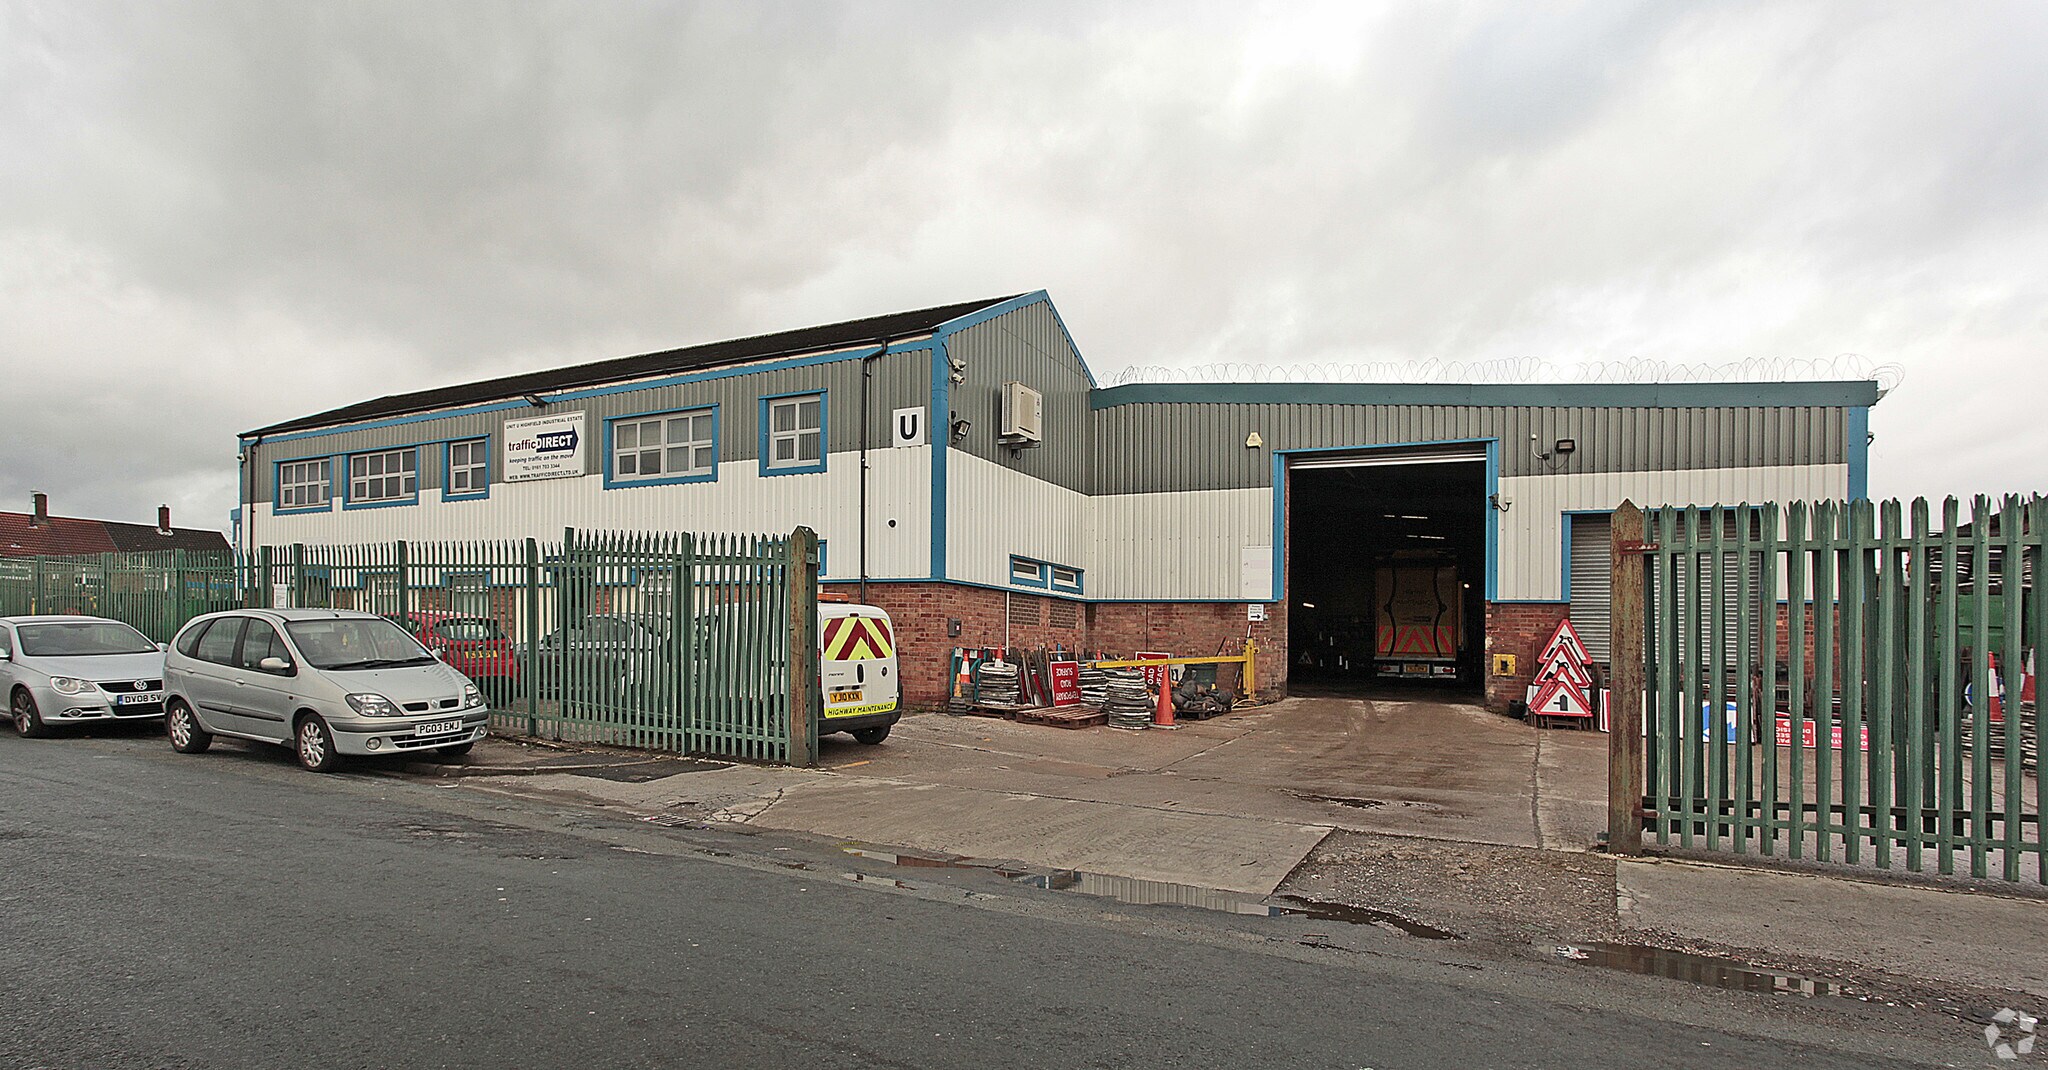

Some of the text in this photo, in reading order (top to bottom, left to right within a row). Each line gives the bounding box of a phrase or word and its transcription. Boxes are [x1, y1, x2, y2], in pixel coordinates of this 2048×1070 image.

[800, 414, 817, 440] U
[509, 456, 527, 464] keeping
[1147, 668, 1155, 685] OAD
[125, 694, 161, 703] DV08 SV
[828, 703, 893, 716] HIGHWAY MAINTENANCE
[419, 723, 442, 734] PG03
